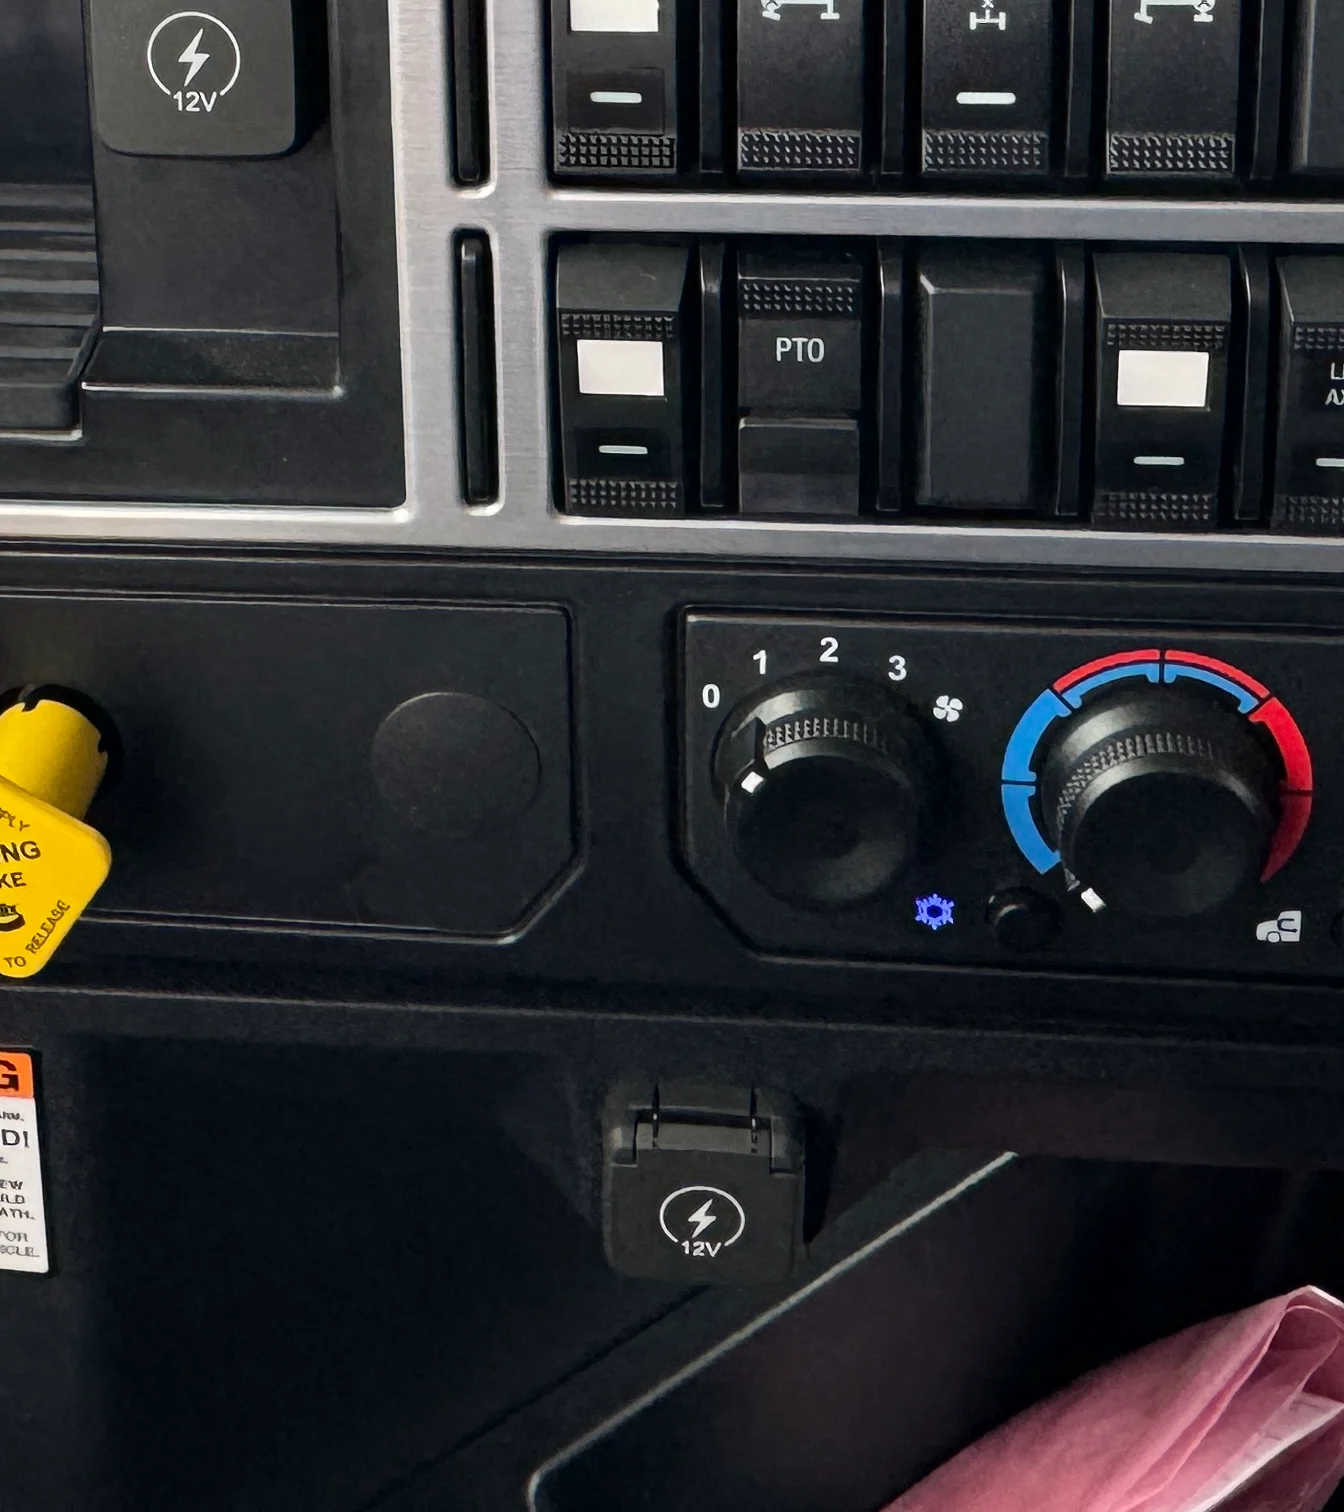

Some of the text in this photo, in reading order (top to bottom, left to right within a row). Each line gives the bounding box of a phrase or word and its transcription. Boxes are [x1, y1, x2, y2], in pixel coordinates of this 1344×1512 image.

[173, 91, 217, 112] 12V
[775, 337, 825, 364] PTO
[702, 637, 907, 708] 0 1 2 3
[3, 956, 27, 968] TO
[25, 900, 71, 954] RELEASE
[681, 1241, 722, 1258] 12V
